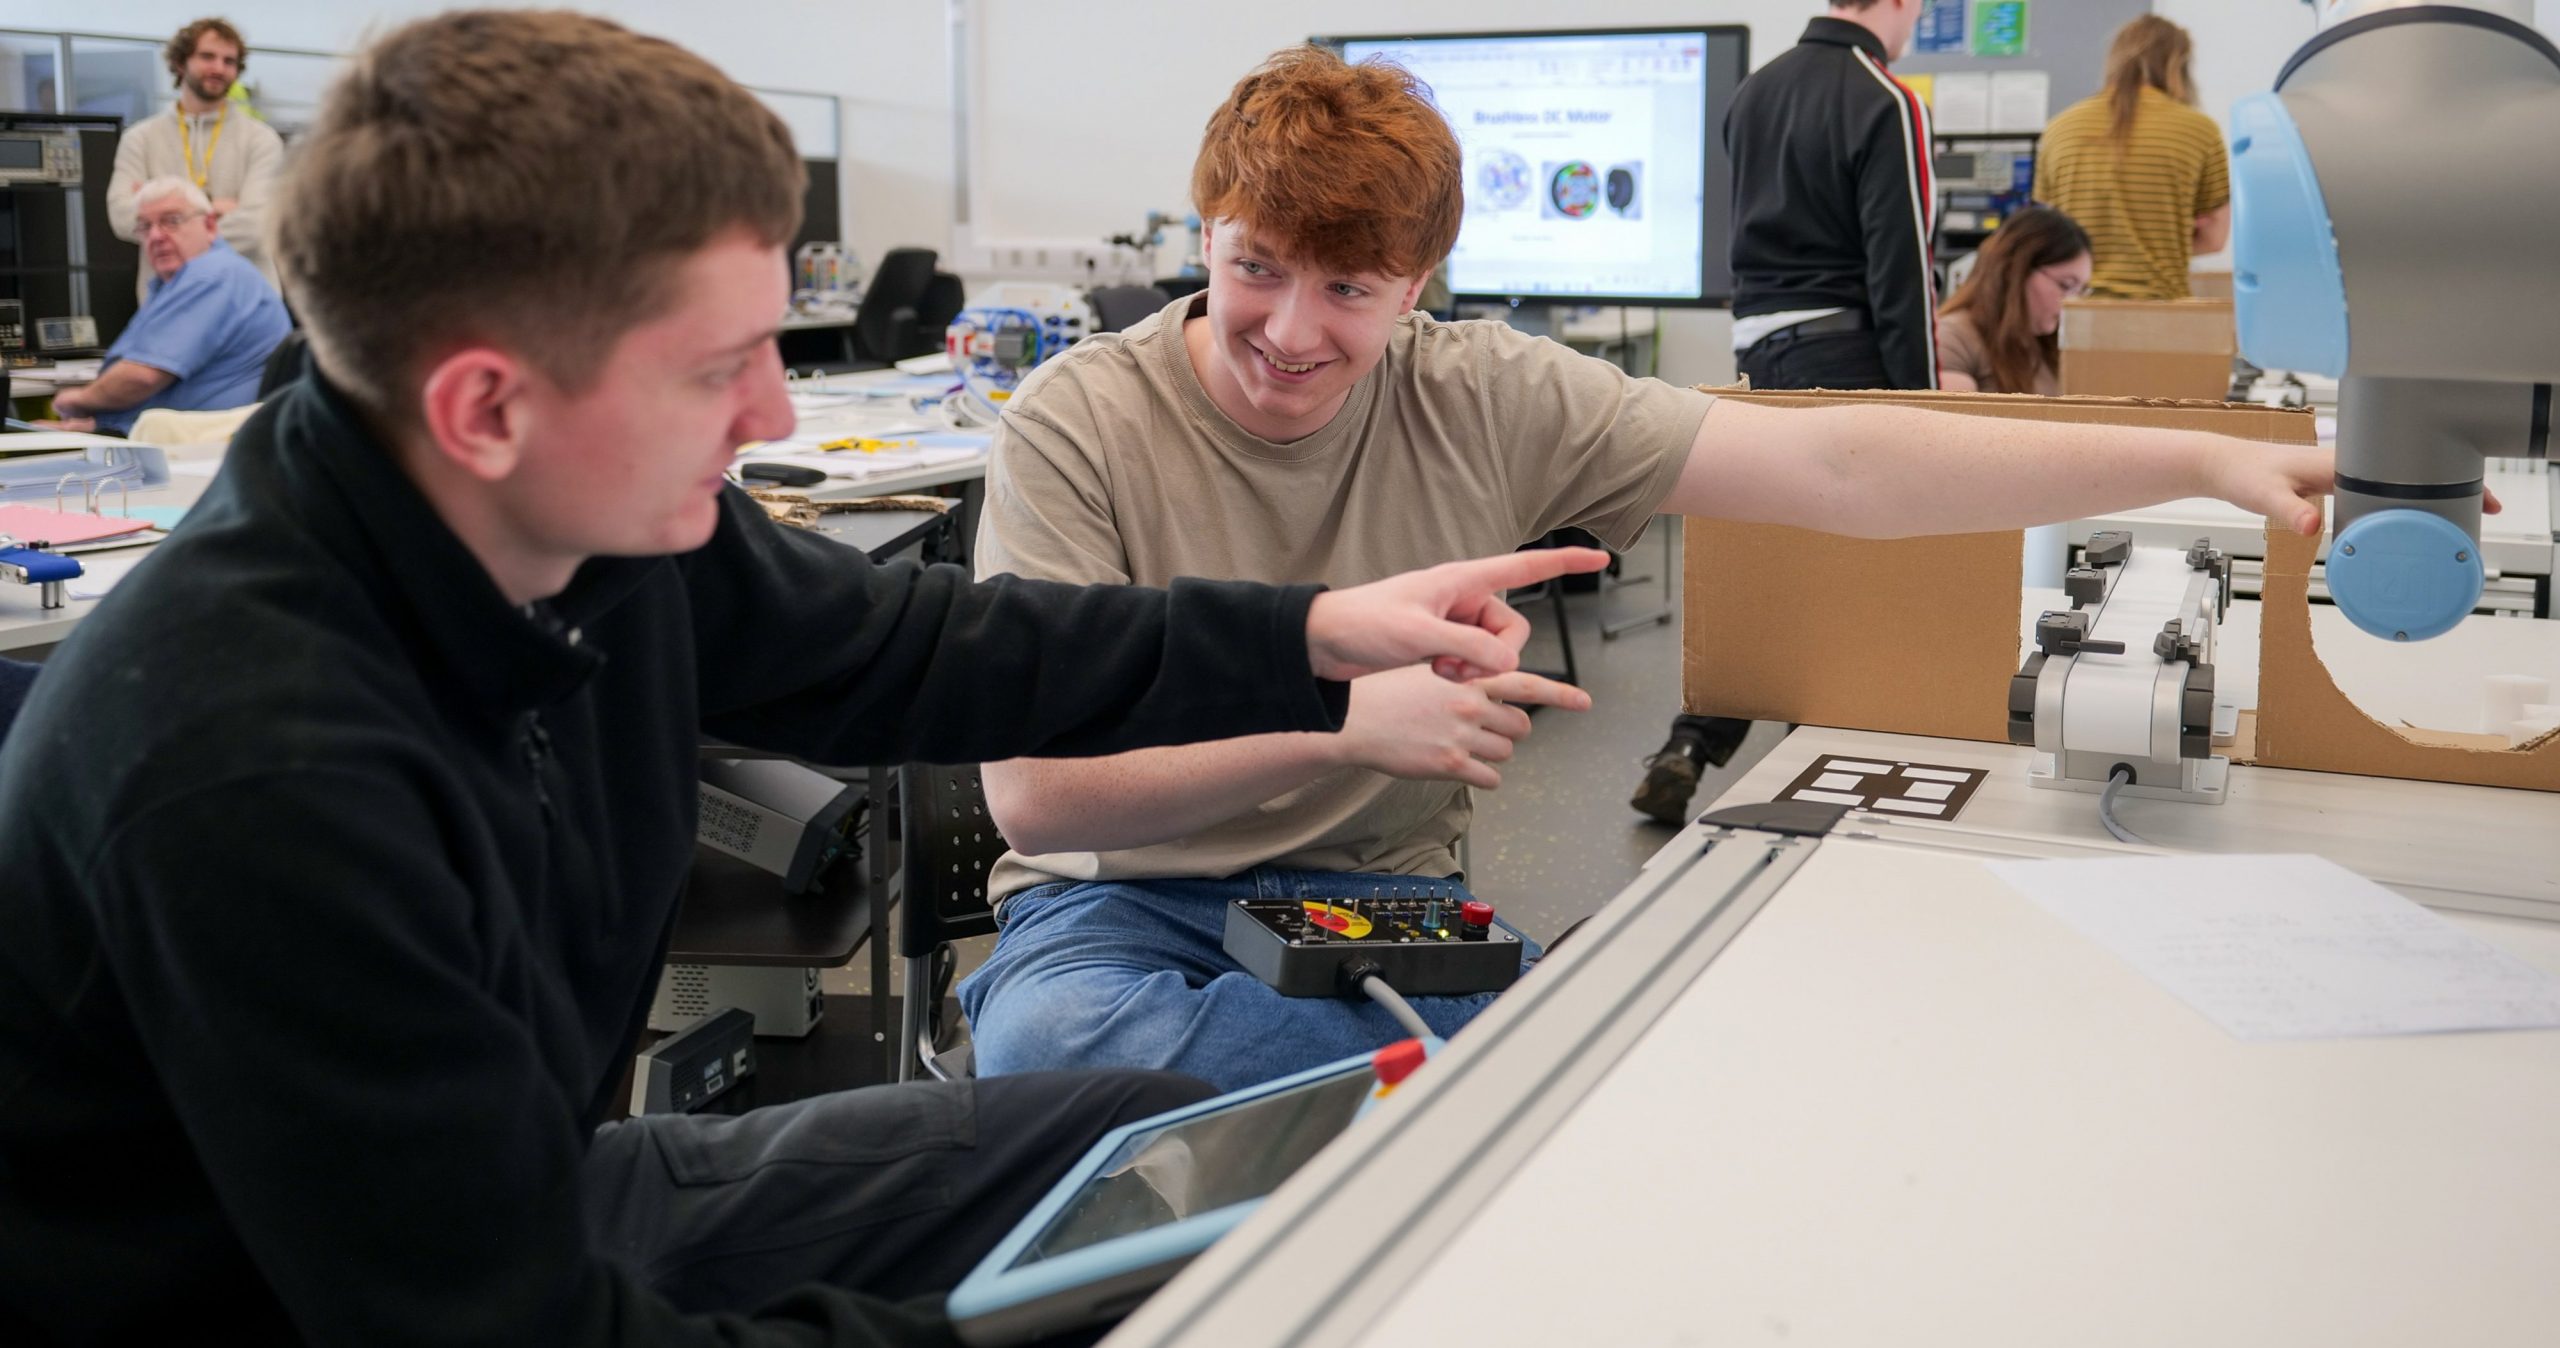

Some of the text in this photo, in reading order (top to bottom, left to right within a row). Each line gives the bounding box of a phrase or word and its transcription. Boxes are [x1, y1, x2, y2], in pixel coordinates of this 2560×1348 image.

[1473, 108, 1612, 124] Brushless DC Motor
